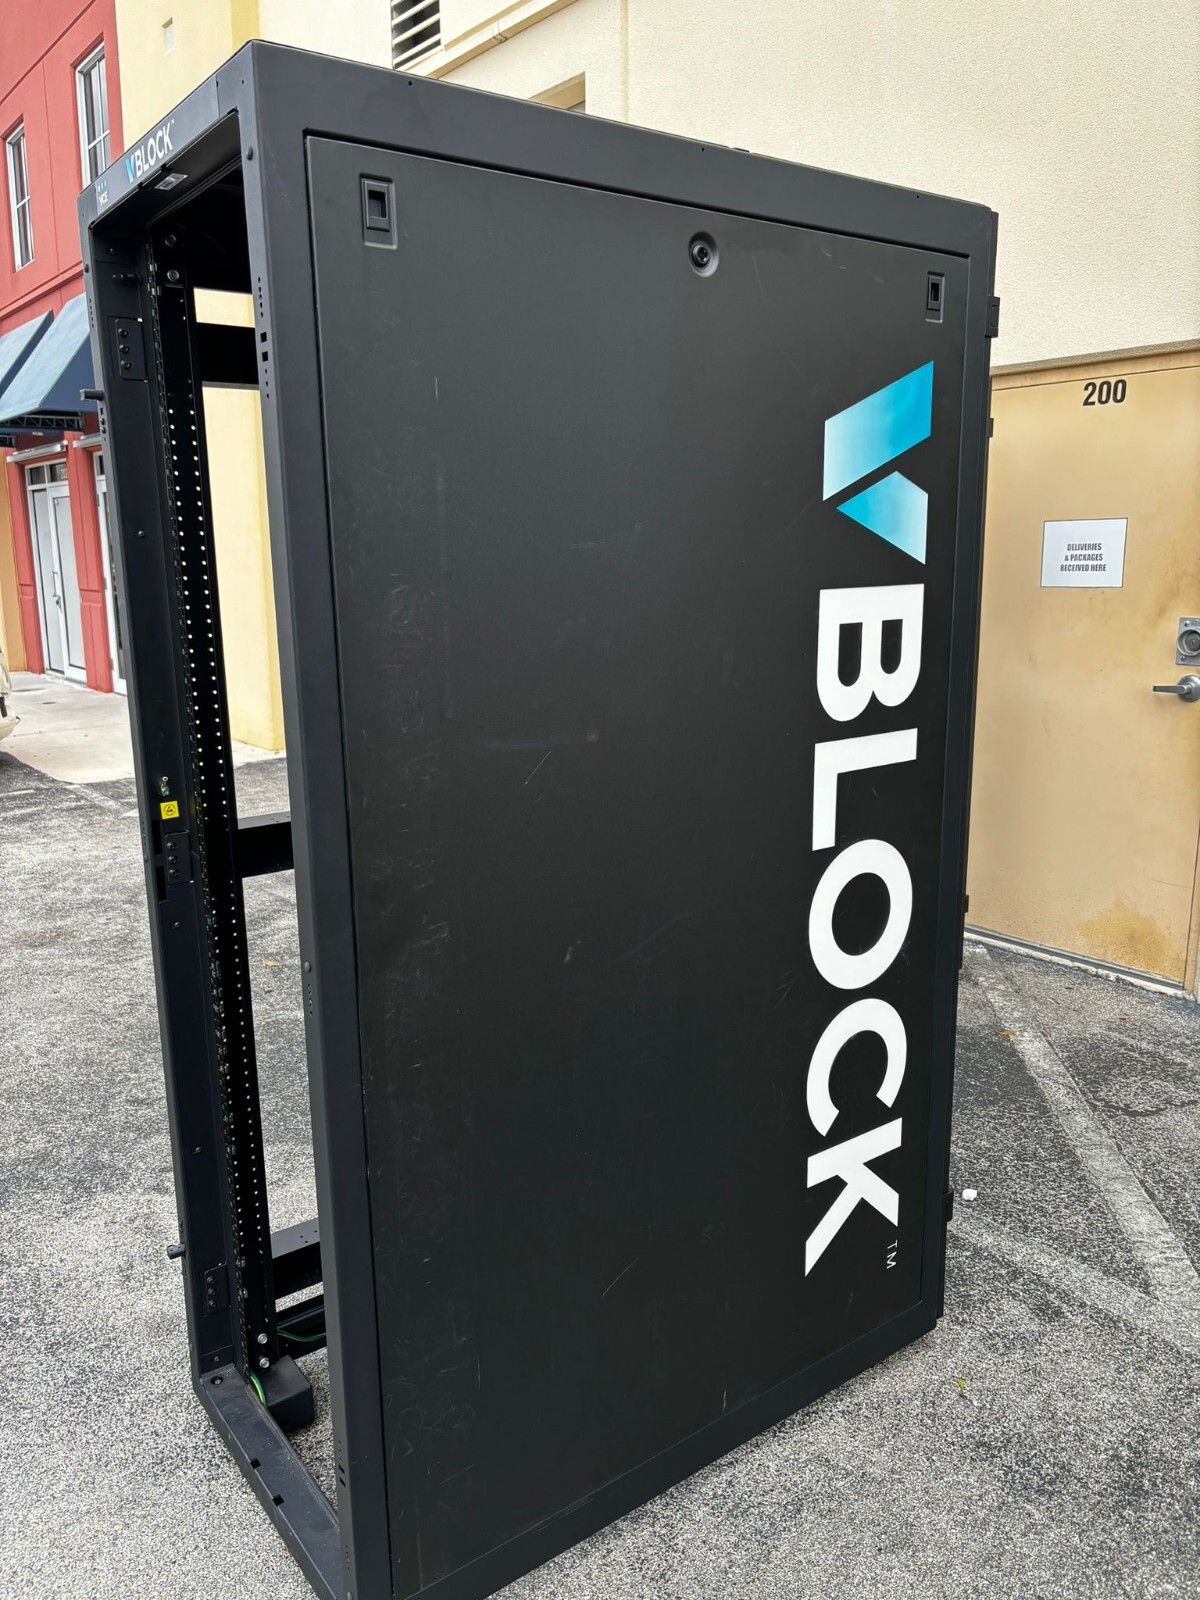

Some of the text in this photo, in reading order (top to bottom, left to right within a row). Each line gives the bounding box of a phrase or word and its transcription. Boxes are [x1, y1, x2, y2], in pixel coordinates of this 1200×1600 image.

[125, 124, 173, 184] VBLOCK
[1082, 379, 1127, 406] 200
[1067, 542, 1102, 551] DELIVERIES
[1070, 553, 1103, 561] PACKAGES
[804, 360, 934, 1277] VBLOCK TM
